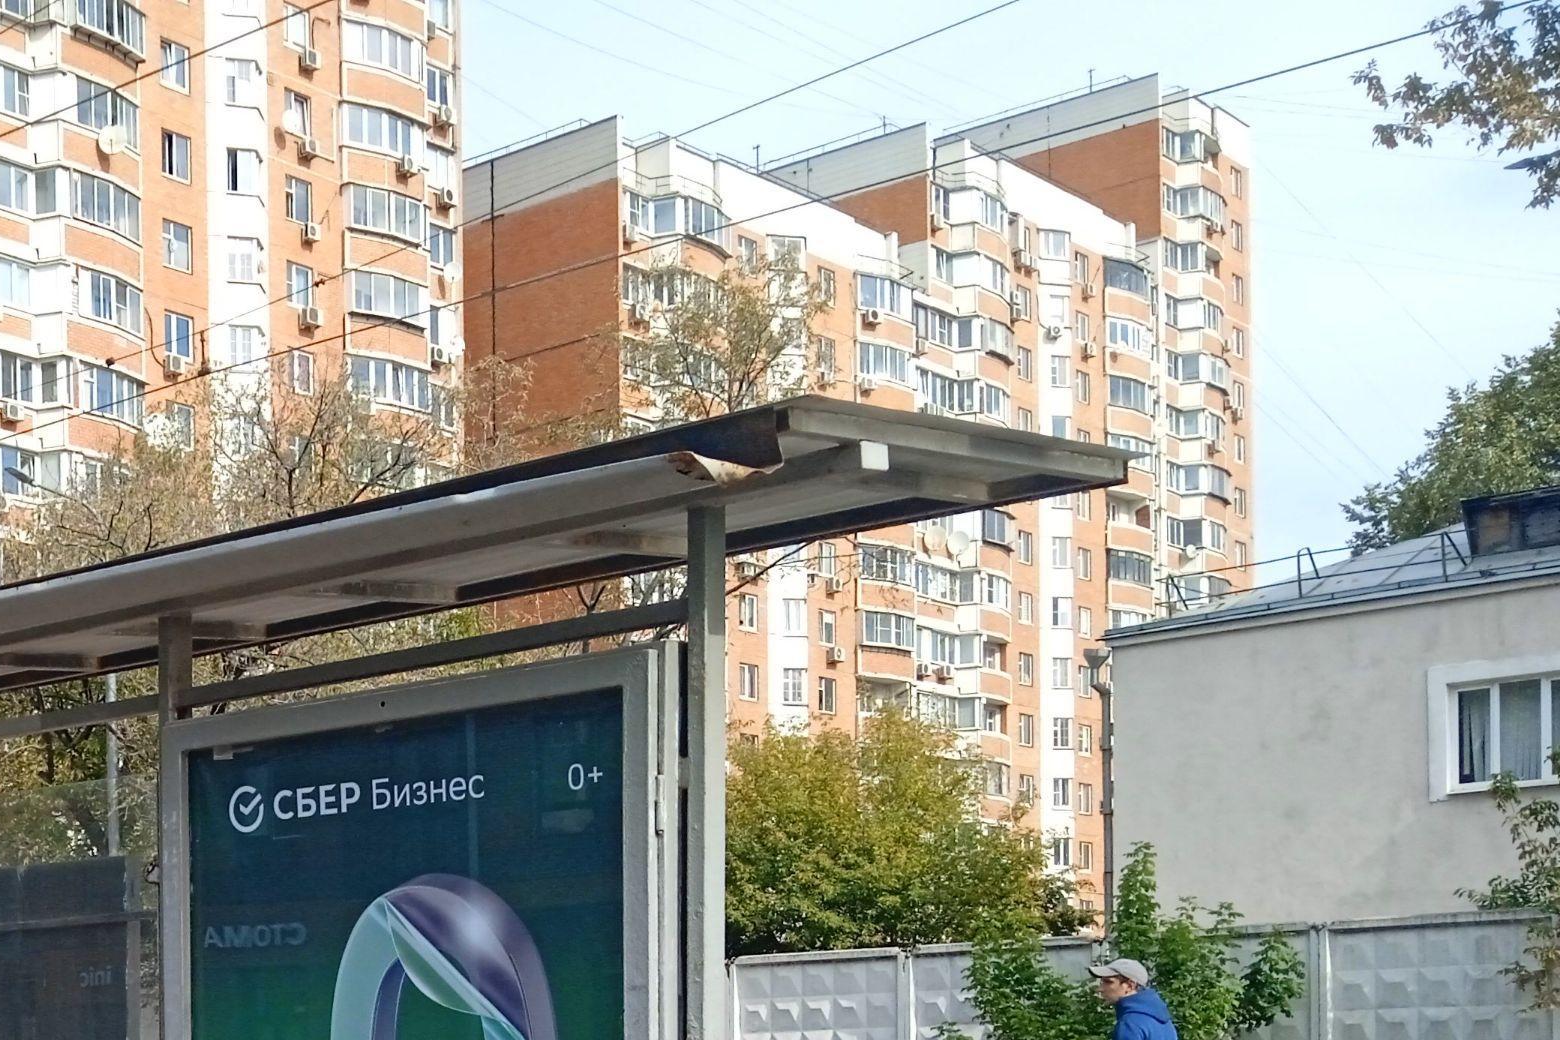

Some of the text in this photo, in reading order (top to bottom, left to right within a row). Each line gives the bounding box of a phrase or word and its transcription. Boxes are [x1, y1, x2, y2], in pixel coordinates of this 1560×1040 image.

[567, 763, 603, 791] 0+
[273, 774, 485, 820] СБЕР Бизнес
